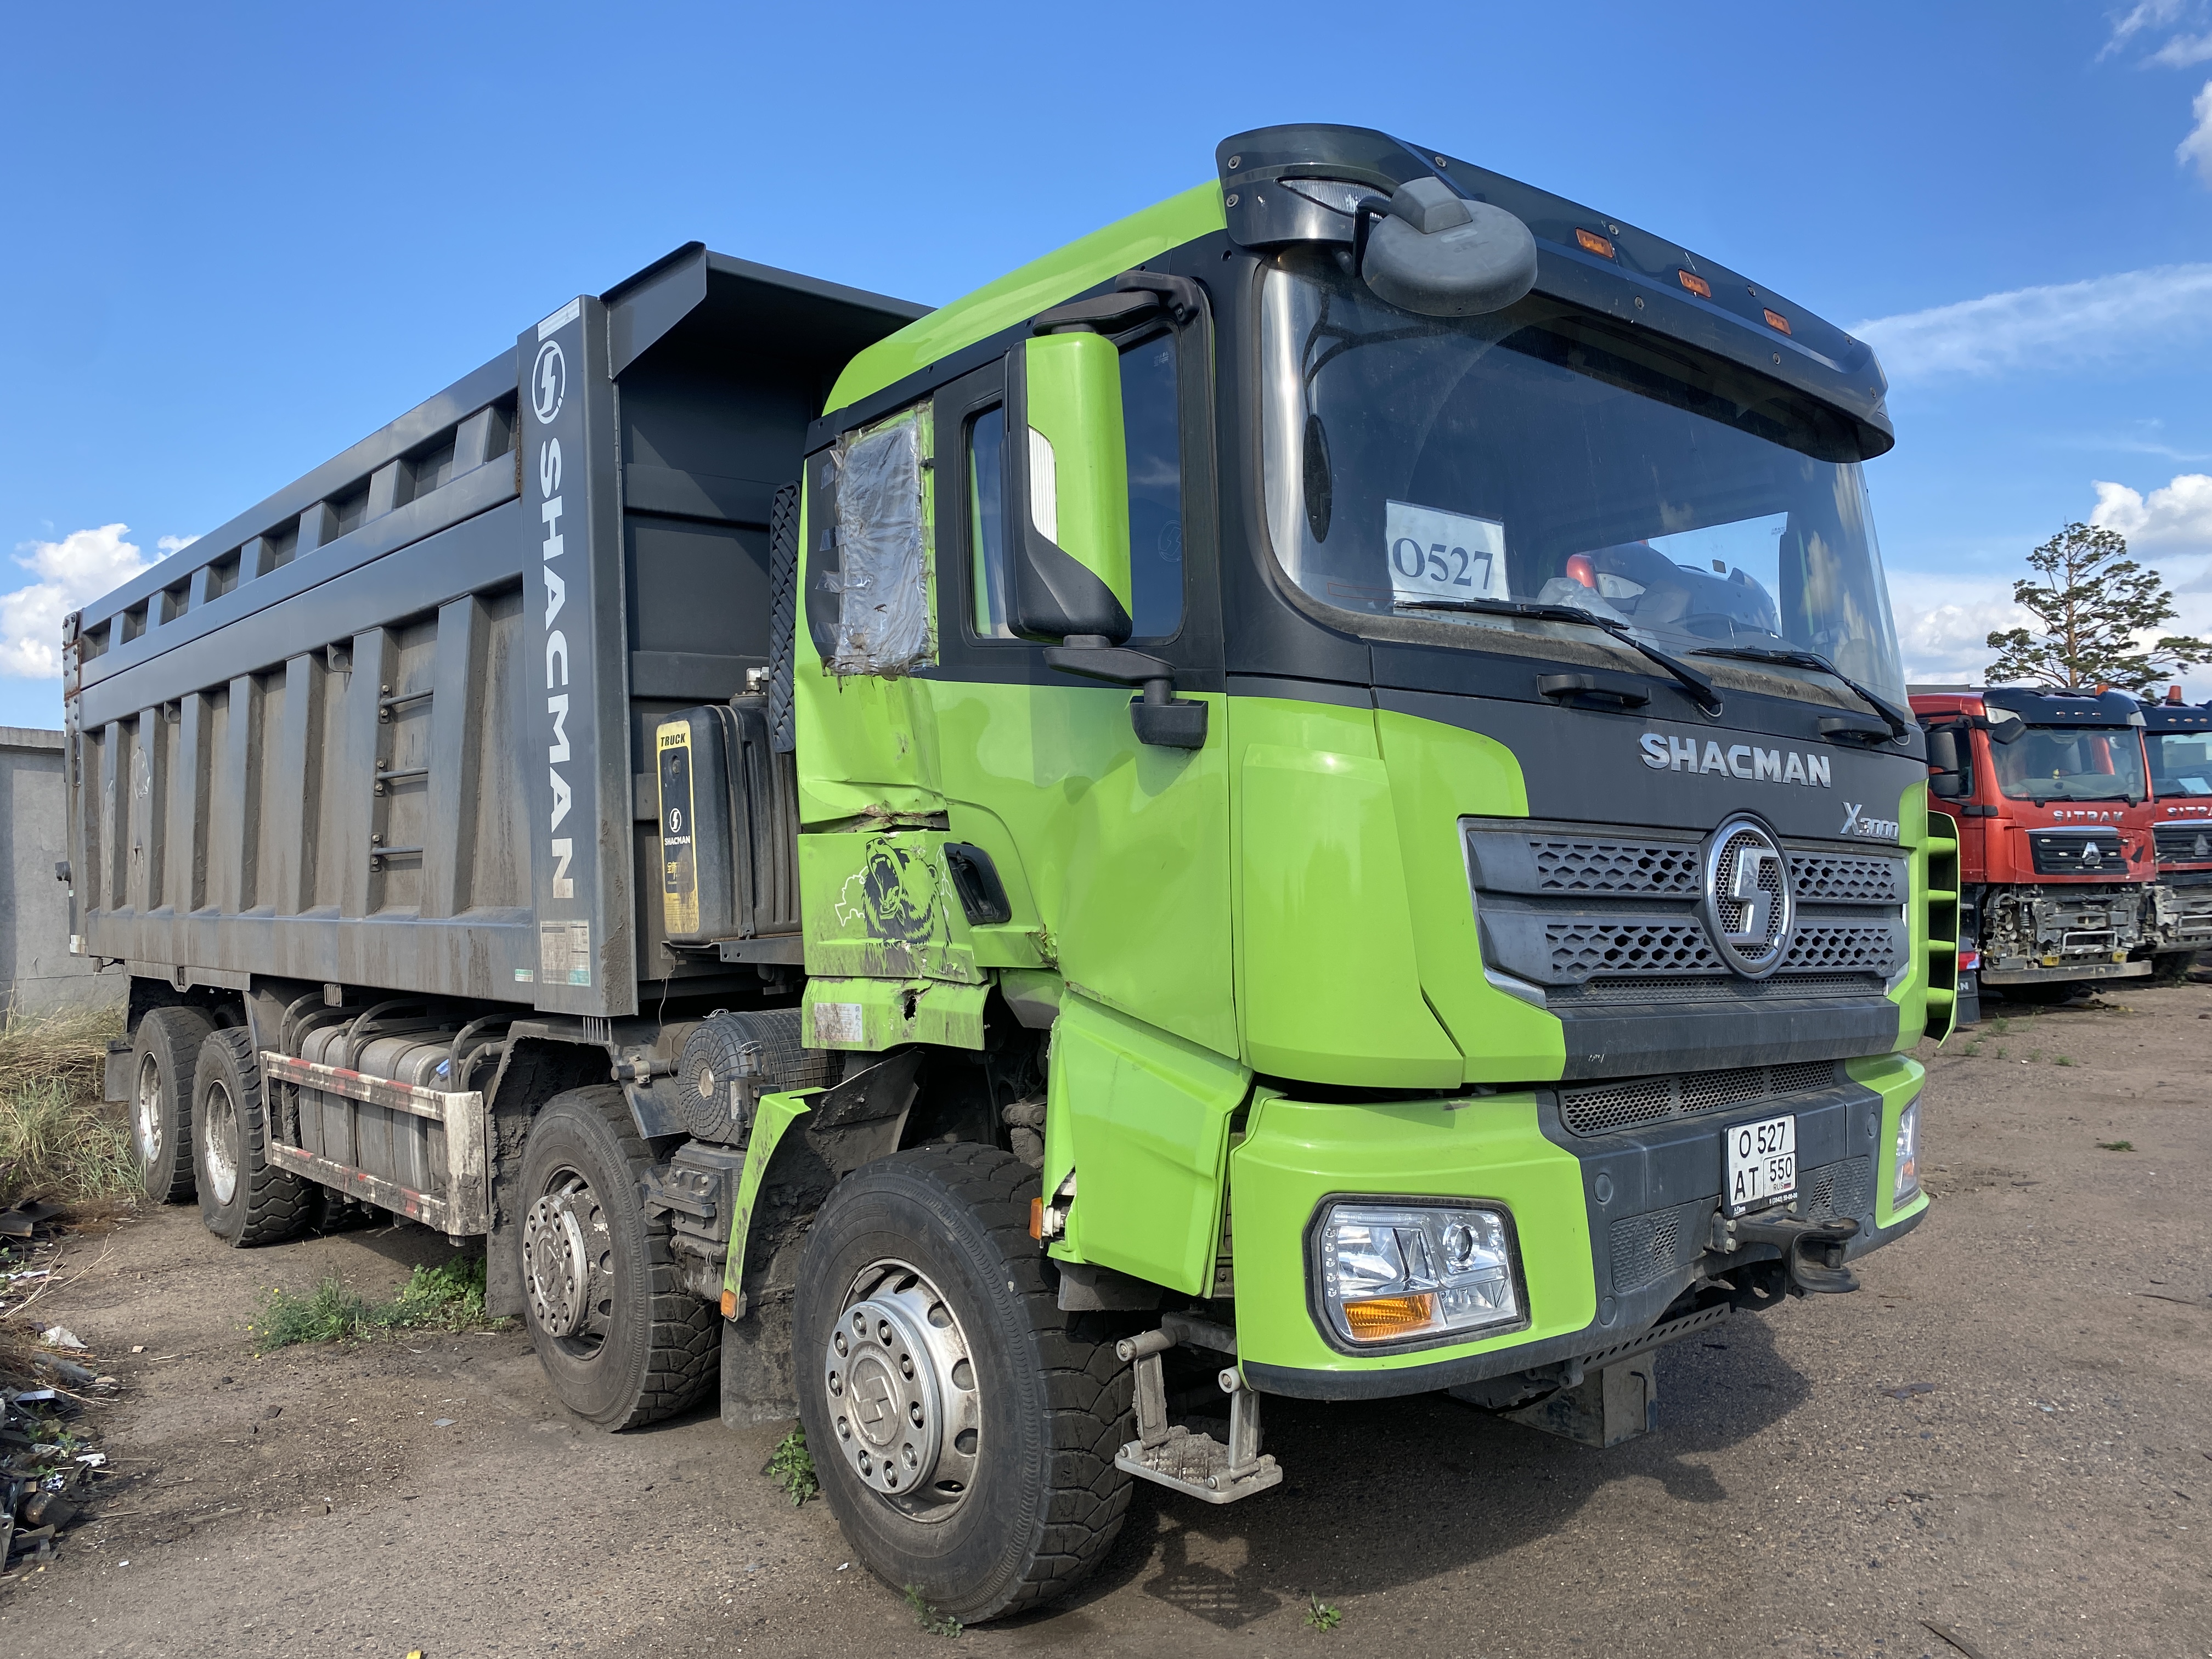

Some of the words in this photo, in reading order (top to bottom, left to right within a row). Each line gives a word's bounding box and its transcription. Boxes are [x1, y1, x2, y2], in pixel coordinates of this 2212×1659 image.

[539, 437, 574, 900] SHACMAN
[660, 732, 686, 747] TRUCK
[1639, 733, 1831, 788] SHACMAN
[1839, 802, 1899, 840] X3000
[2052, 810, 2124, 823] SITRAK
[664, 835, 691, 845] SHACMAN
[1757, 1121, 1785, 1154] 527
[1769, 1156, 1792, 1182] 550
[1773, 1182, 1784, 1192] RUS
